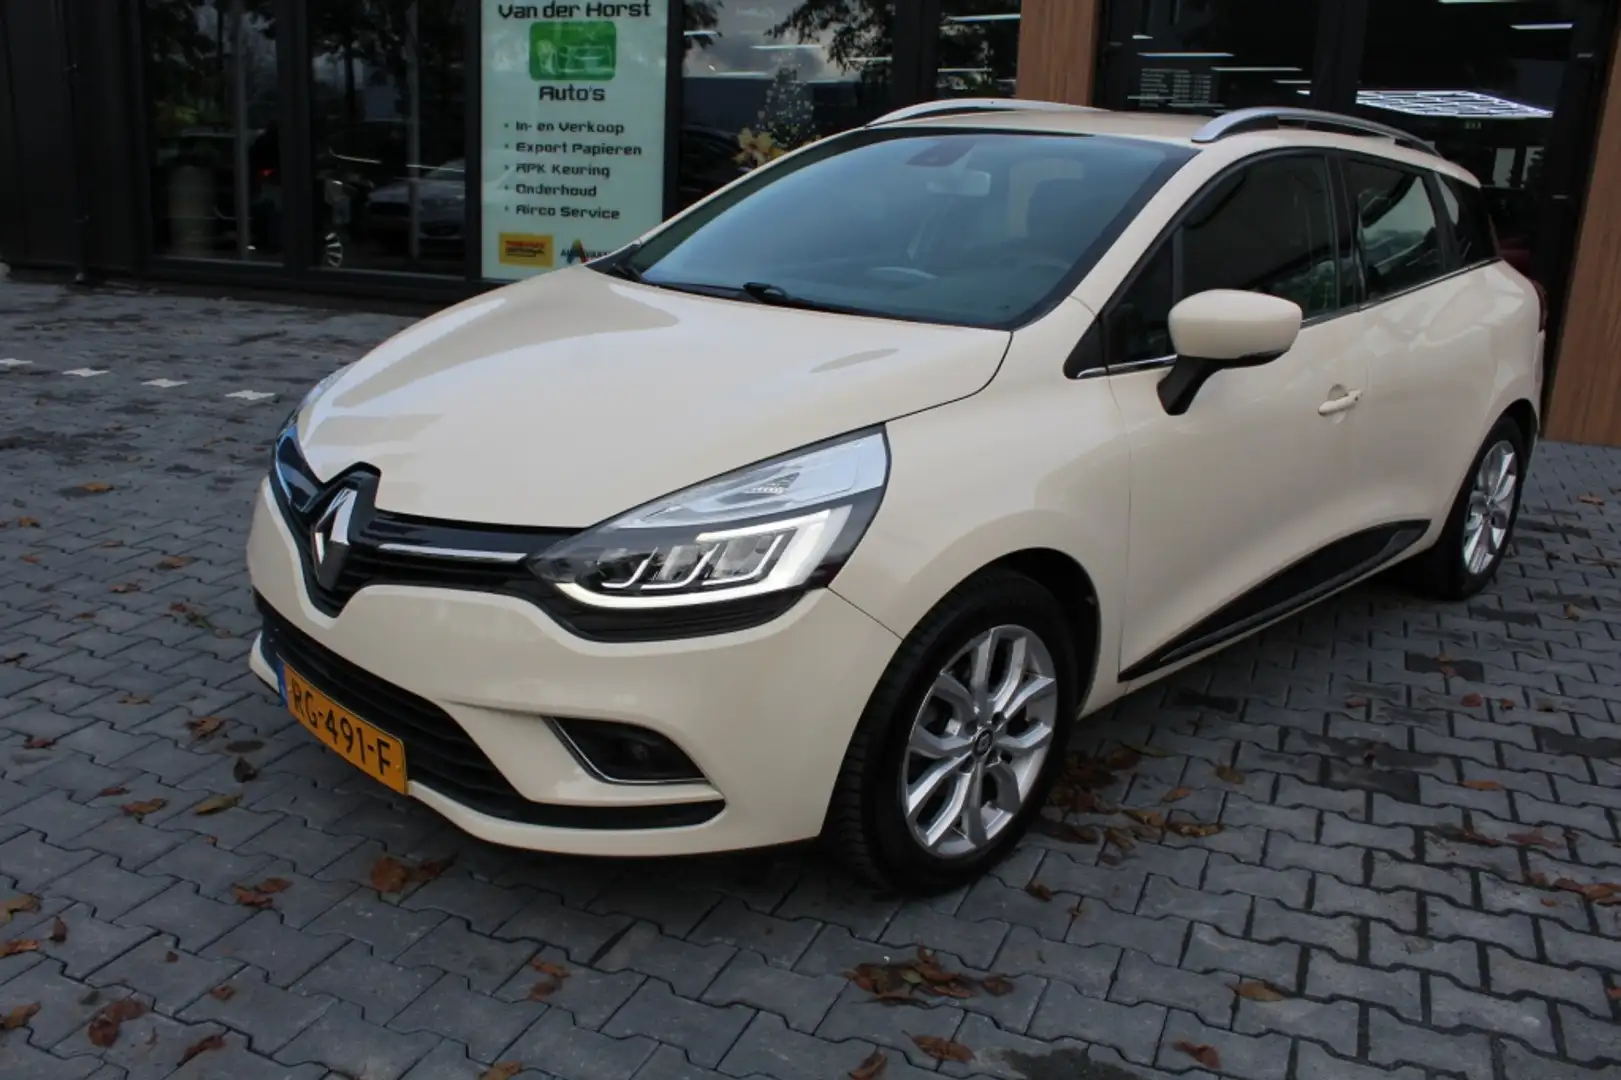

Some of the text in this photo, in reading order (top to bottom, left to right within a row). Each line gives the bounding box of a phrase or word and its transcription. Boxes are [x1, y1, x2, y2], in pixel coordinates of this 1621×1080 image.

[498, 0, 652, 19] Van der Horst
[539, 84, 605, 101] Auto's
[515, 120, 625, 136] In- en Verkoop
[515, 141, 642, 157] Export Papieren
[515, 162, 611, 179] APK Keuring
[515, 183, 597, 197] Onderhoud
[515, 203, 620, 220] Airco Service
[291, 677, 391, 776] RG-491-F
